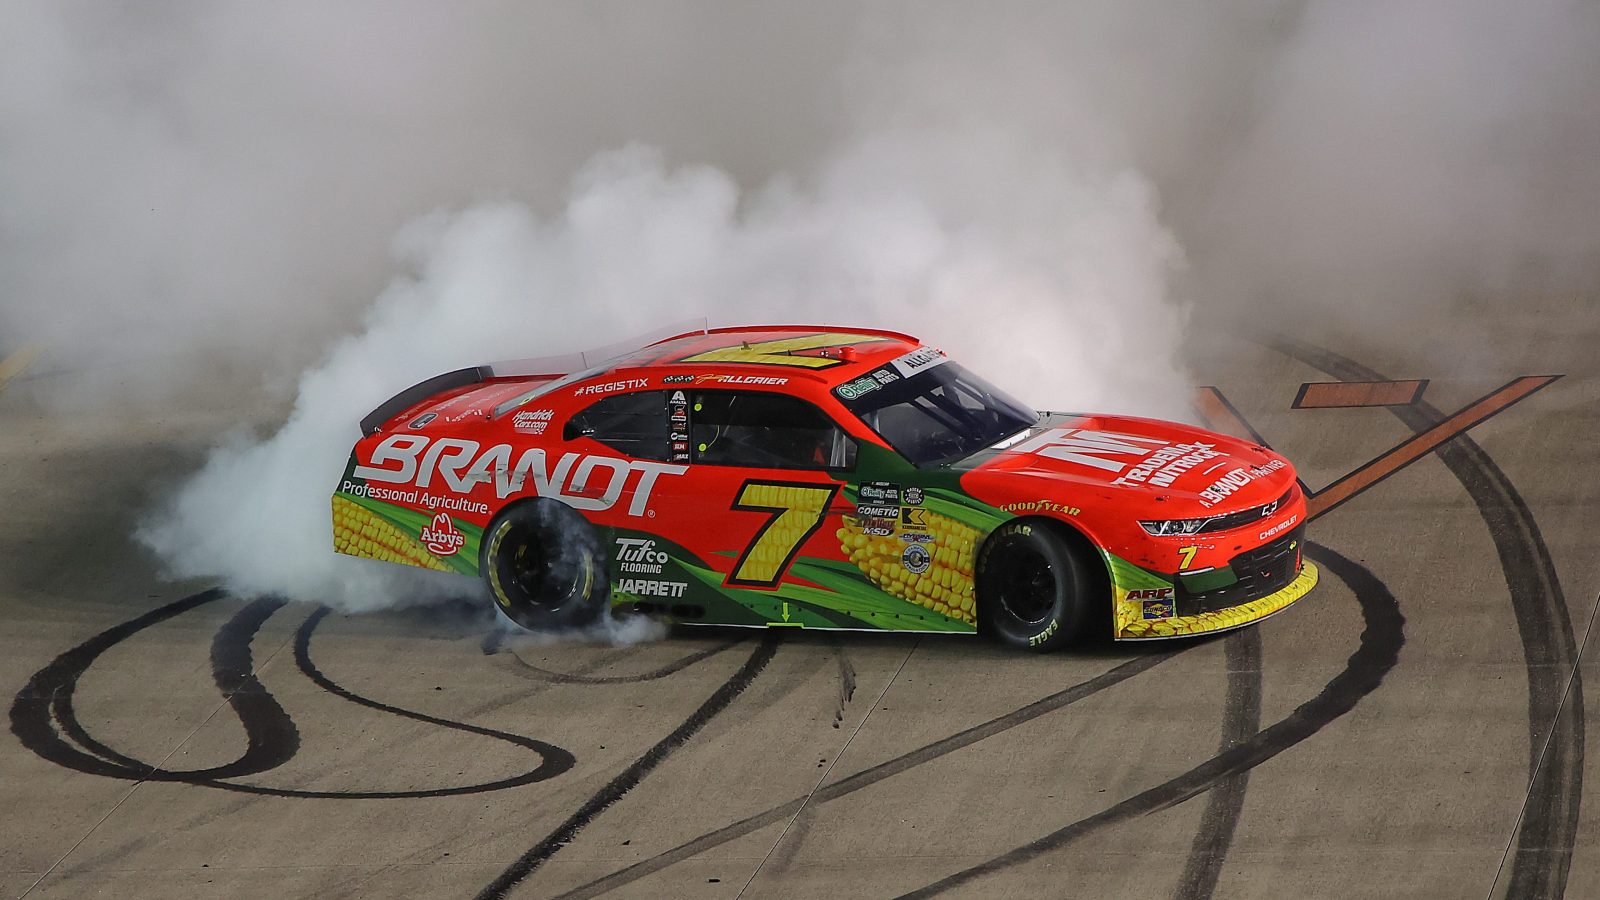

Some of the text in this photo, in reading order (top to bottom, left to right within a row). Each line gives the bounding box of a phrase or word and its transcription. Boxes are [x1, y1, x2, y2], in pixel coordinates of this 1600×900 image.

[717, 376, 789, 386] ALLGAIER
[512, 409, 555, 421] Hendrick
[352, 434, 690, 517] BRANDT
[1199, 467, 1254, 504] BRANDT
[341, 480, 488, 515] Professional Agriculture
[999, 499, 1081, 516] GOODYEAR
[857, 506, 899, 517] COMETIC
[729, 478, 841, 588] 7
[863, 527, 890, 536] MSD
[1259, 514, 1298, 540] CHEVROLET
[420, 528, 464, 547] Arby's
[615, 537, 669, 564] Tufco
[1177, 545, 1199, 571] 7
[620, 562, 663, 574] FLOORING
[613, 578, 688, 598] JARRETT
[1126, 587, 1174, 601] ARP
[1029, 618, 1059, 647] EAGLE
